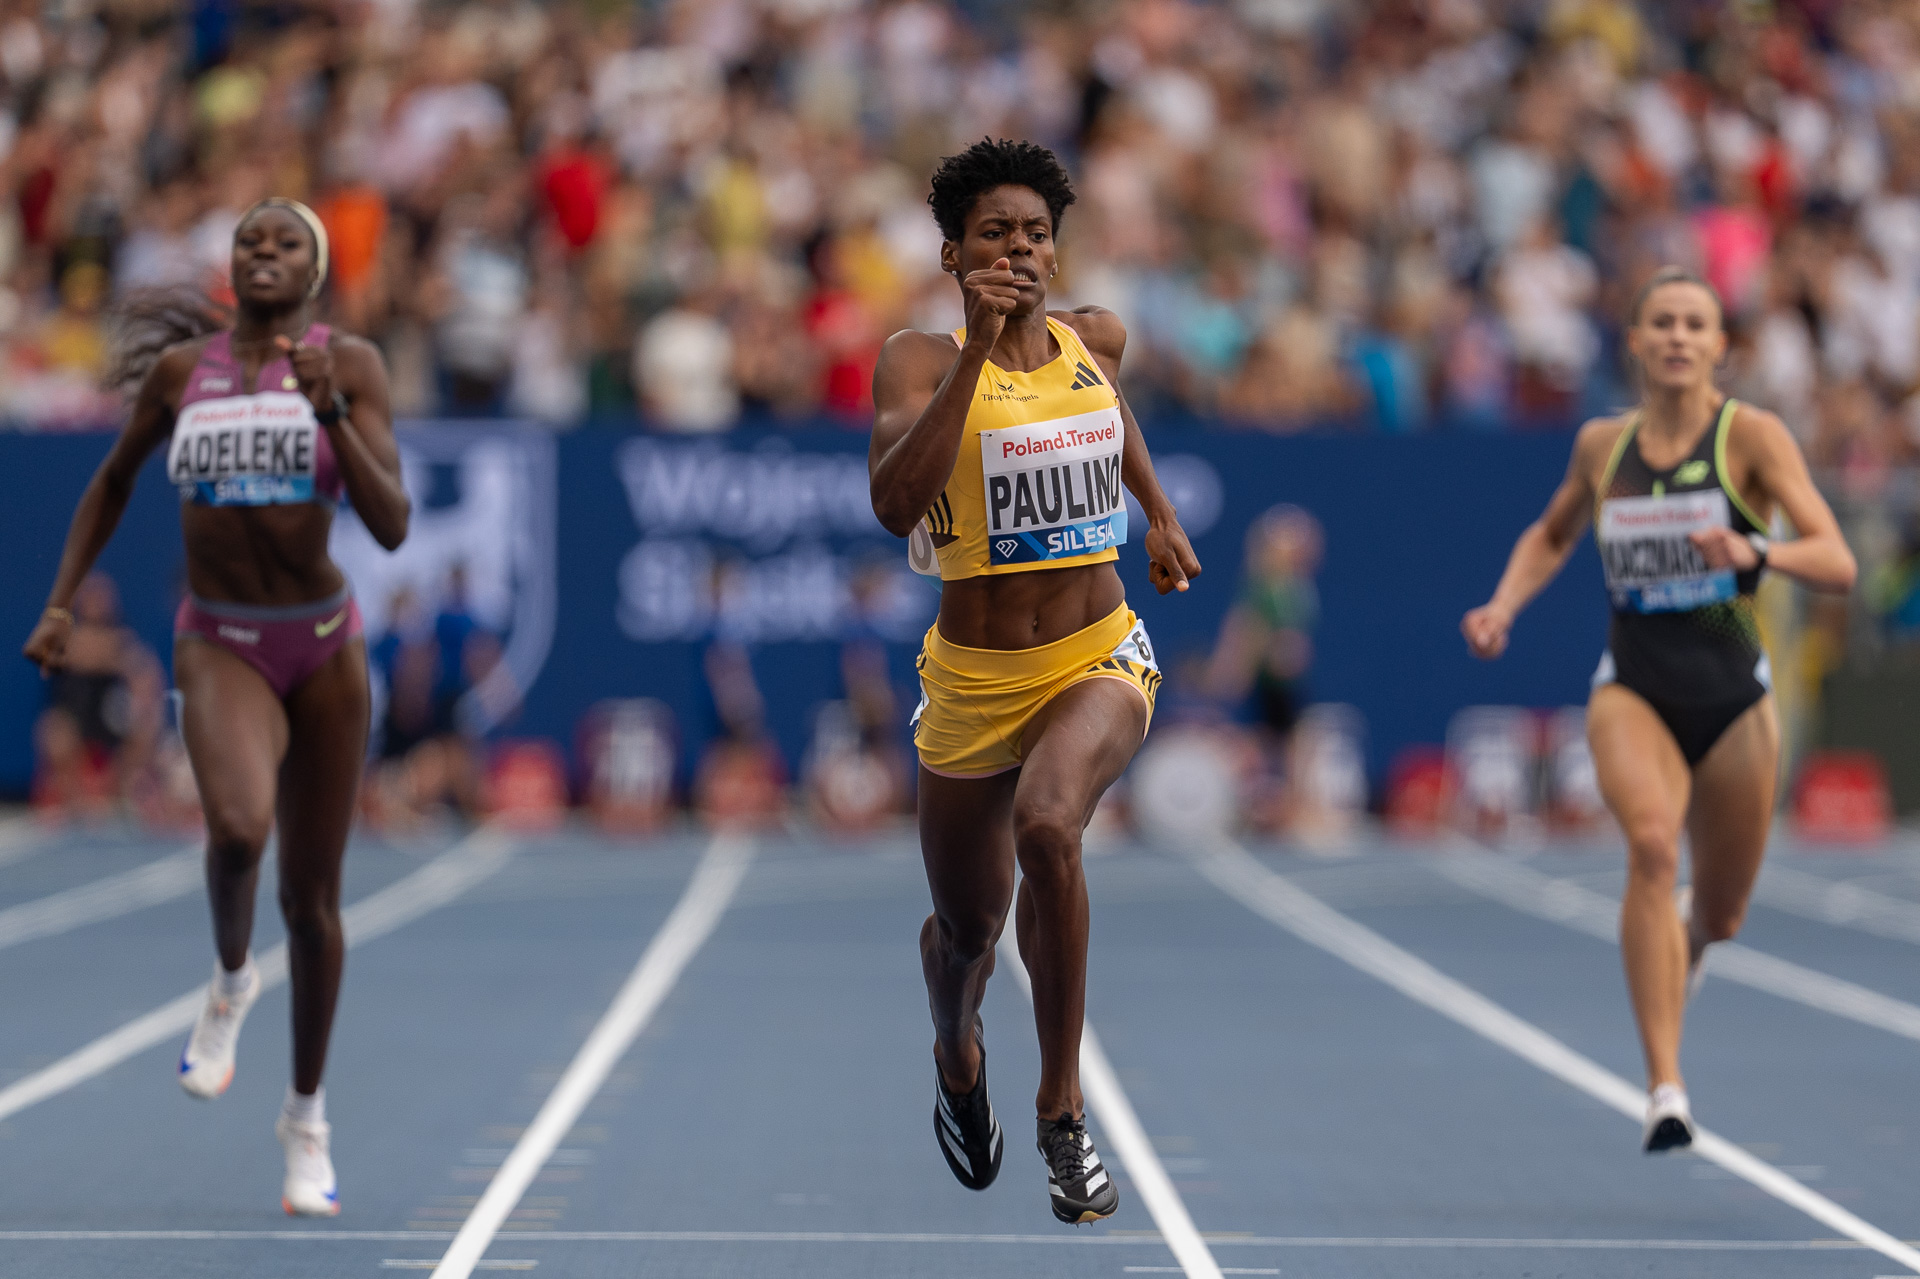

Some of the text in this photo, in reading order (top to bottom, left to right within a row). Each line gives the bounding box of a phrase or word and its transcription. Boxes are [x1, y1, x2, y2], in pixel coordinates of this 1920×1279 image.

[174, 429, 310, 478] ADELEKE
[989, 453, 1120, 531] PAULINO
[1047, 522, 1116, 553] SILESIA
[1132, 631, 1151, 661] 6
